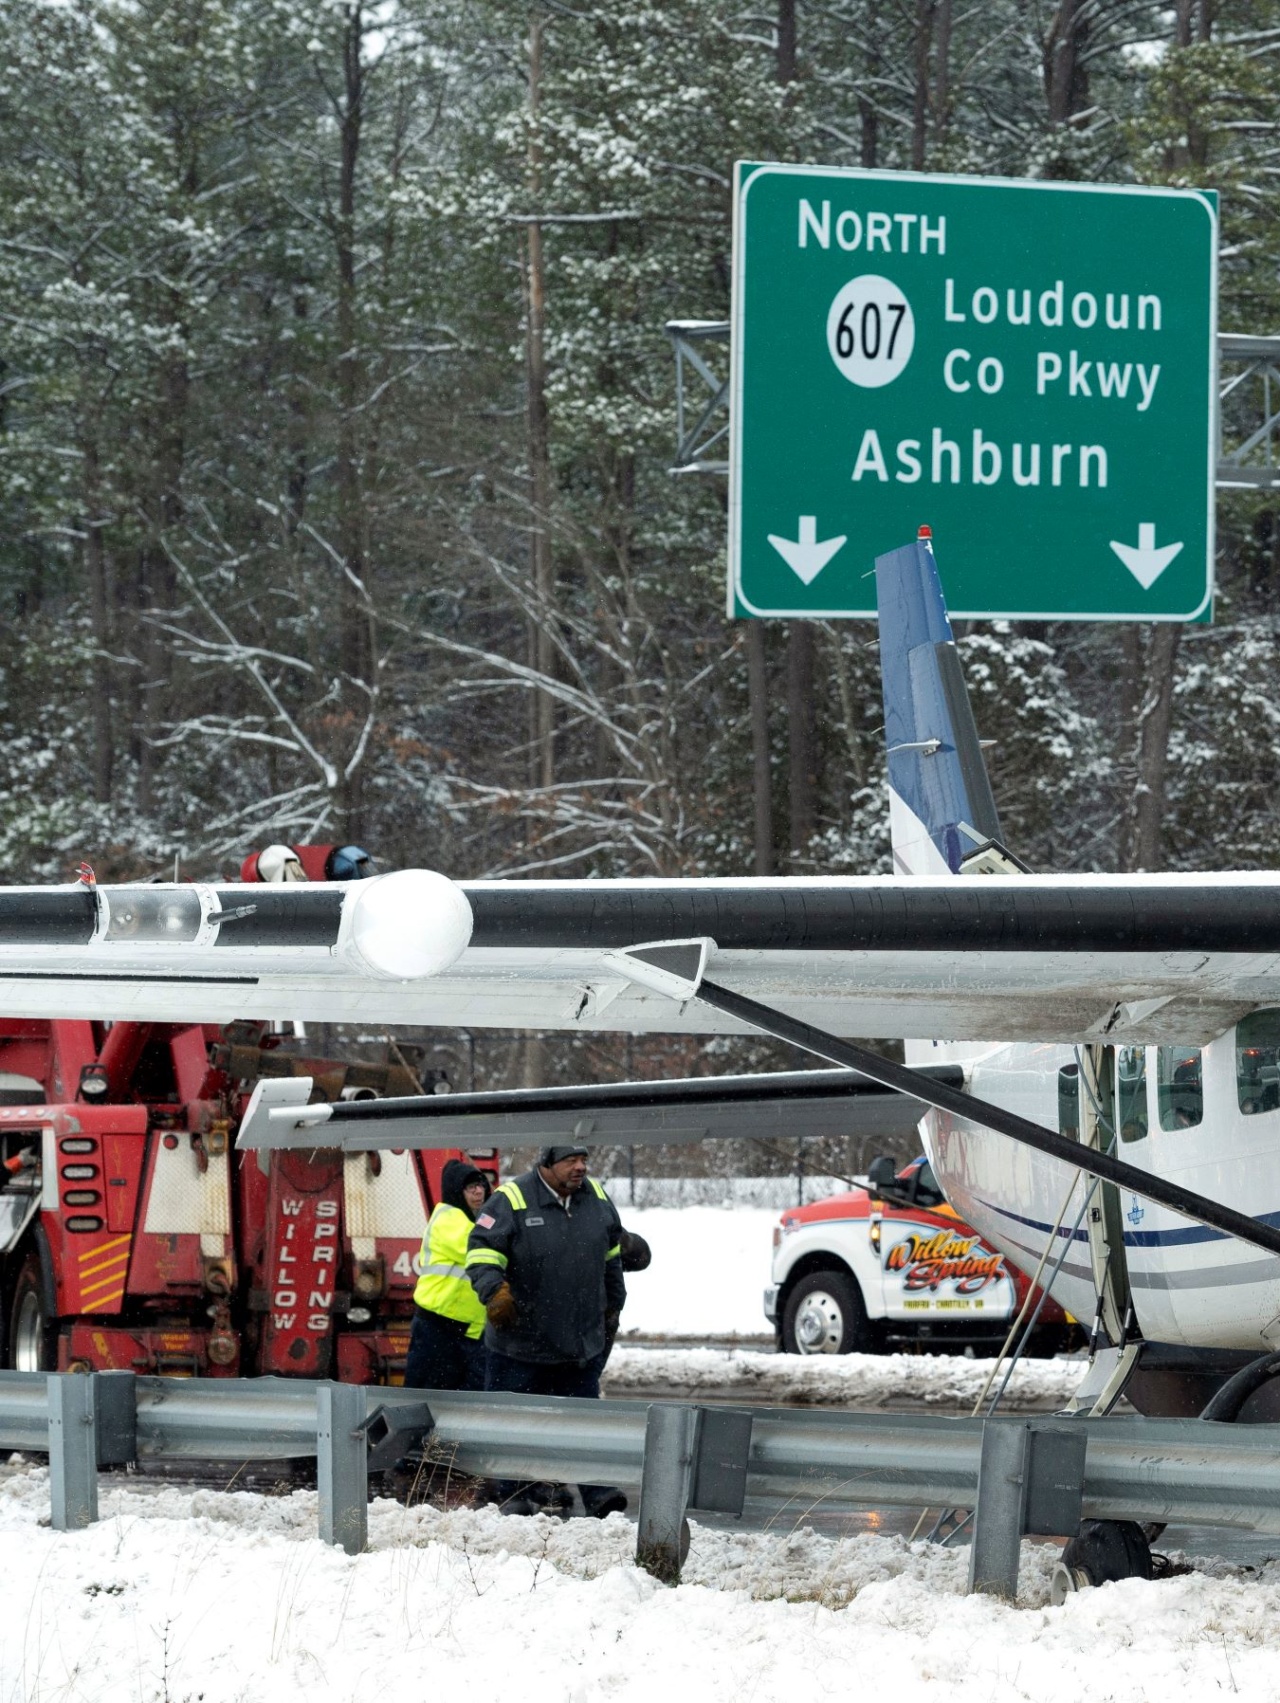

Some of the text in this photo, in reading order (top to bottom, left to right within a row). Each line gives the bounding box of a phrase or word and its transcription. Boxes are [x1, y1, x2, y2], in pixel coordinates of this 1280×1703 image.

[800, 200, 945, 253] NORTH
[836, 303, 905, 359] 607
[946, 280, 1160, 329] Loudoun
[945, 349, 1159, 410] Co Pkwy
[853, 429, 1106, 486] Ashburn
[274, 1200, 304, 1329] WILLOW
[307, 1201, 337, 1330] SPRING
[886, 1231, 979, 1271] Willow
[904, 1254, 1005, 1294] Spring
